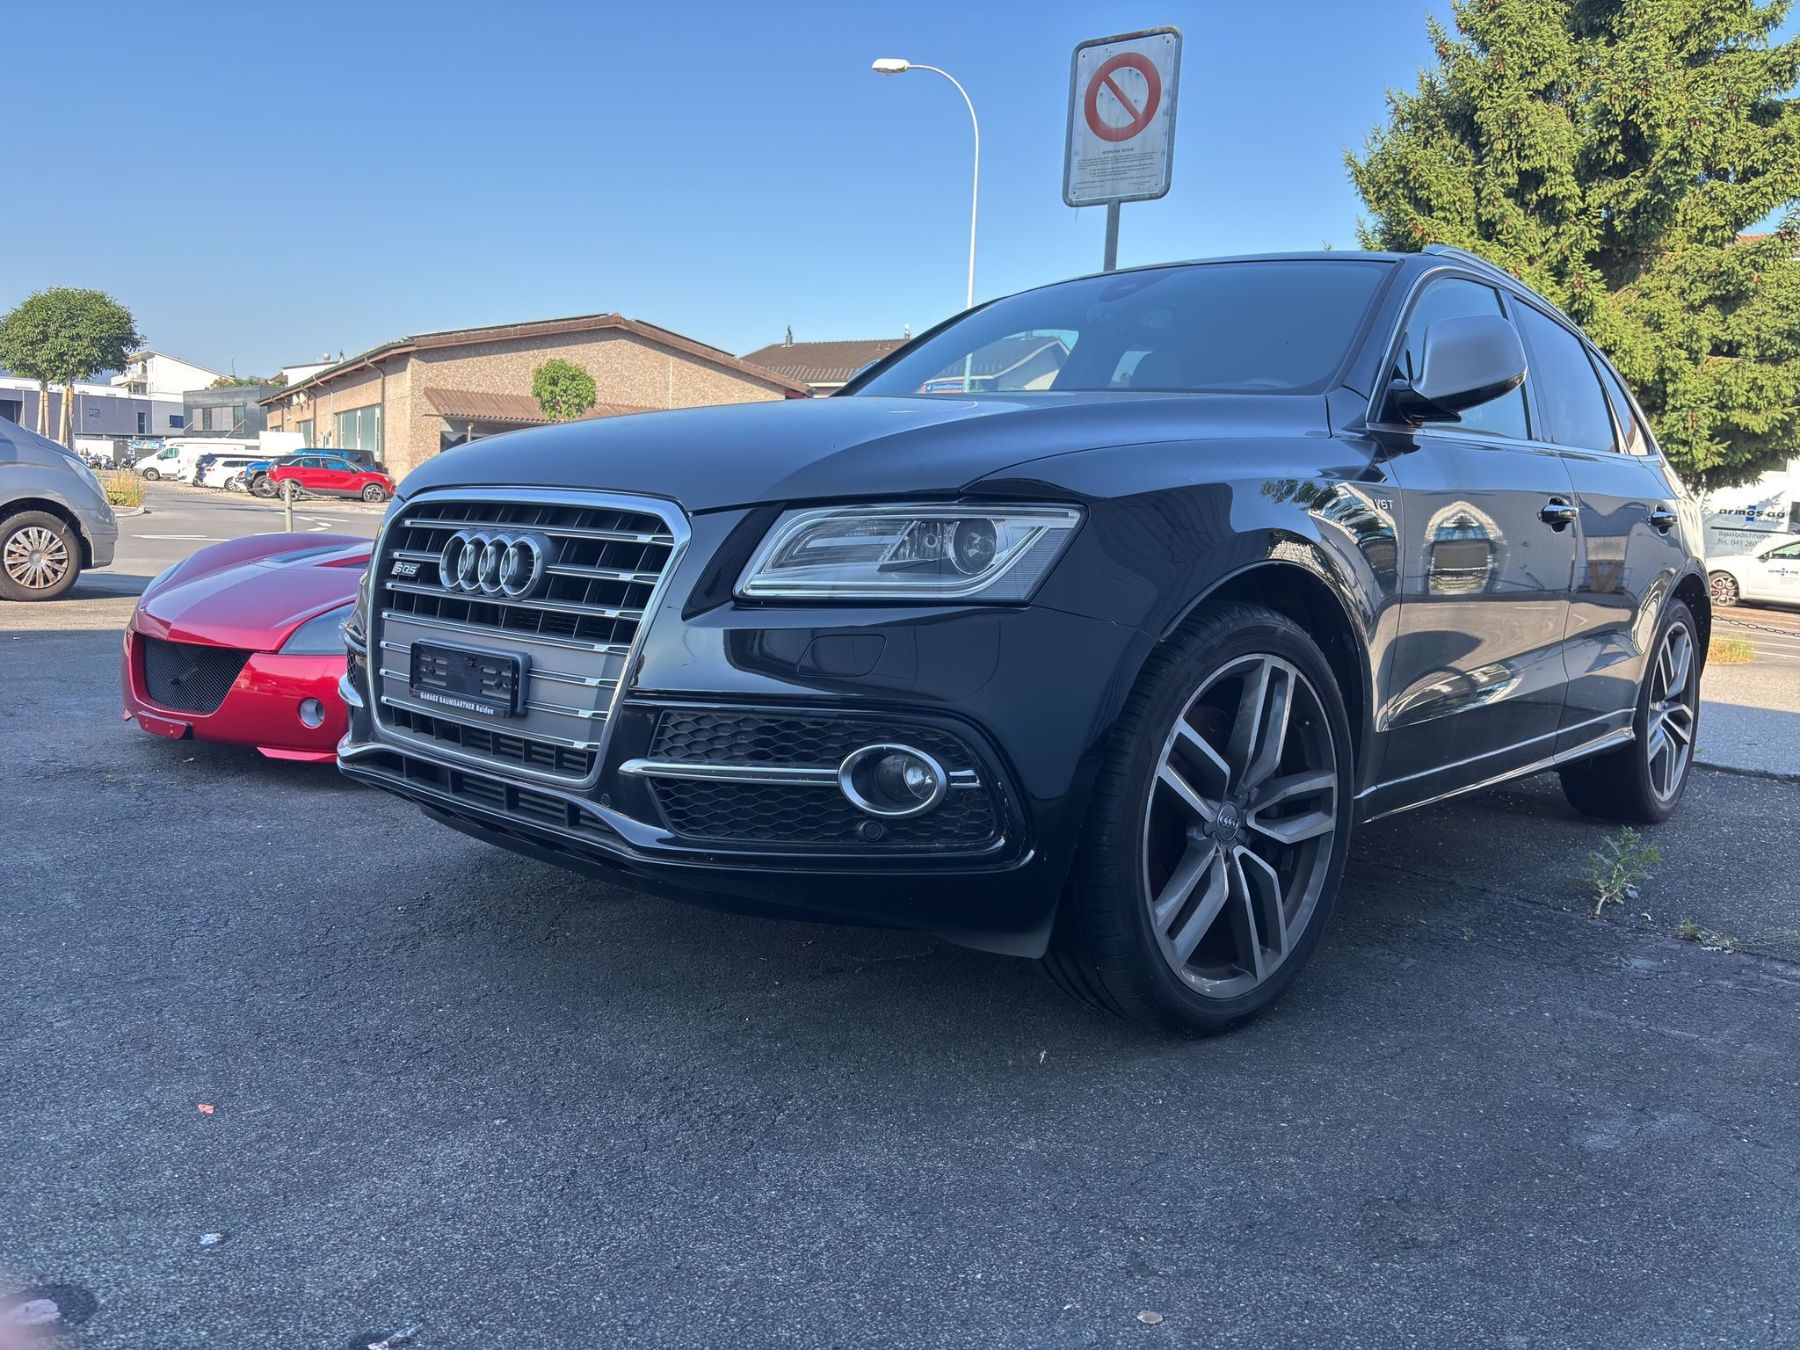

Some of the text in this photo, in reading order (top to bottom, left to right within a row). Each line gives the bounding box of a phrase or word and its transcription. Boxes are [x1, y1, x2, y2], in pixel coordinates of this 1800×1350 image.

[1373, 498, 1393, 510] V6T
[1767, 511, 1786, 519] ag
[420, 692, 438, 702] GARAGE
[439, 696, 475, 710] BAUMGARTNER
